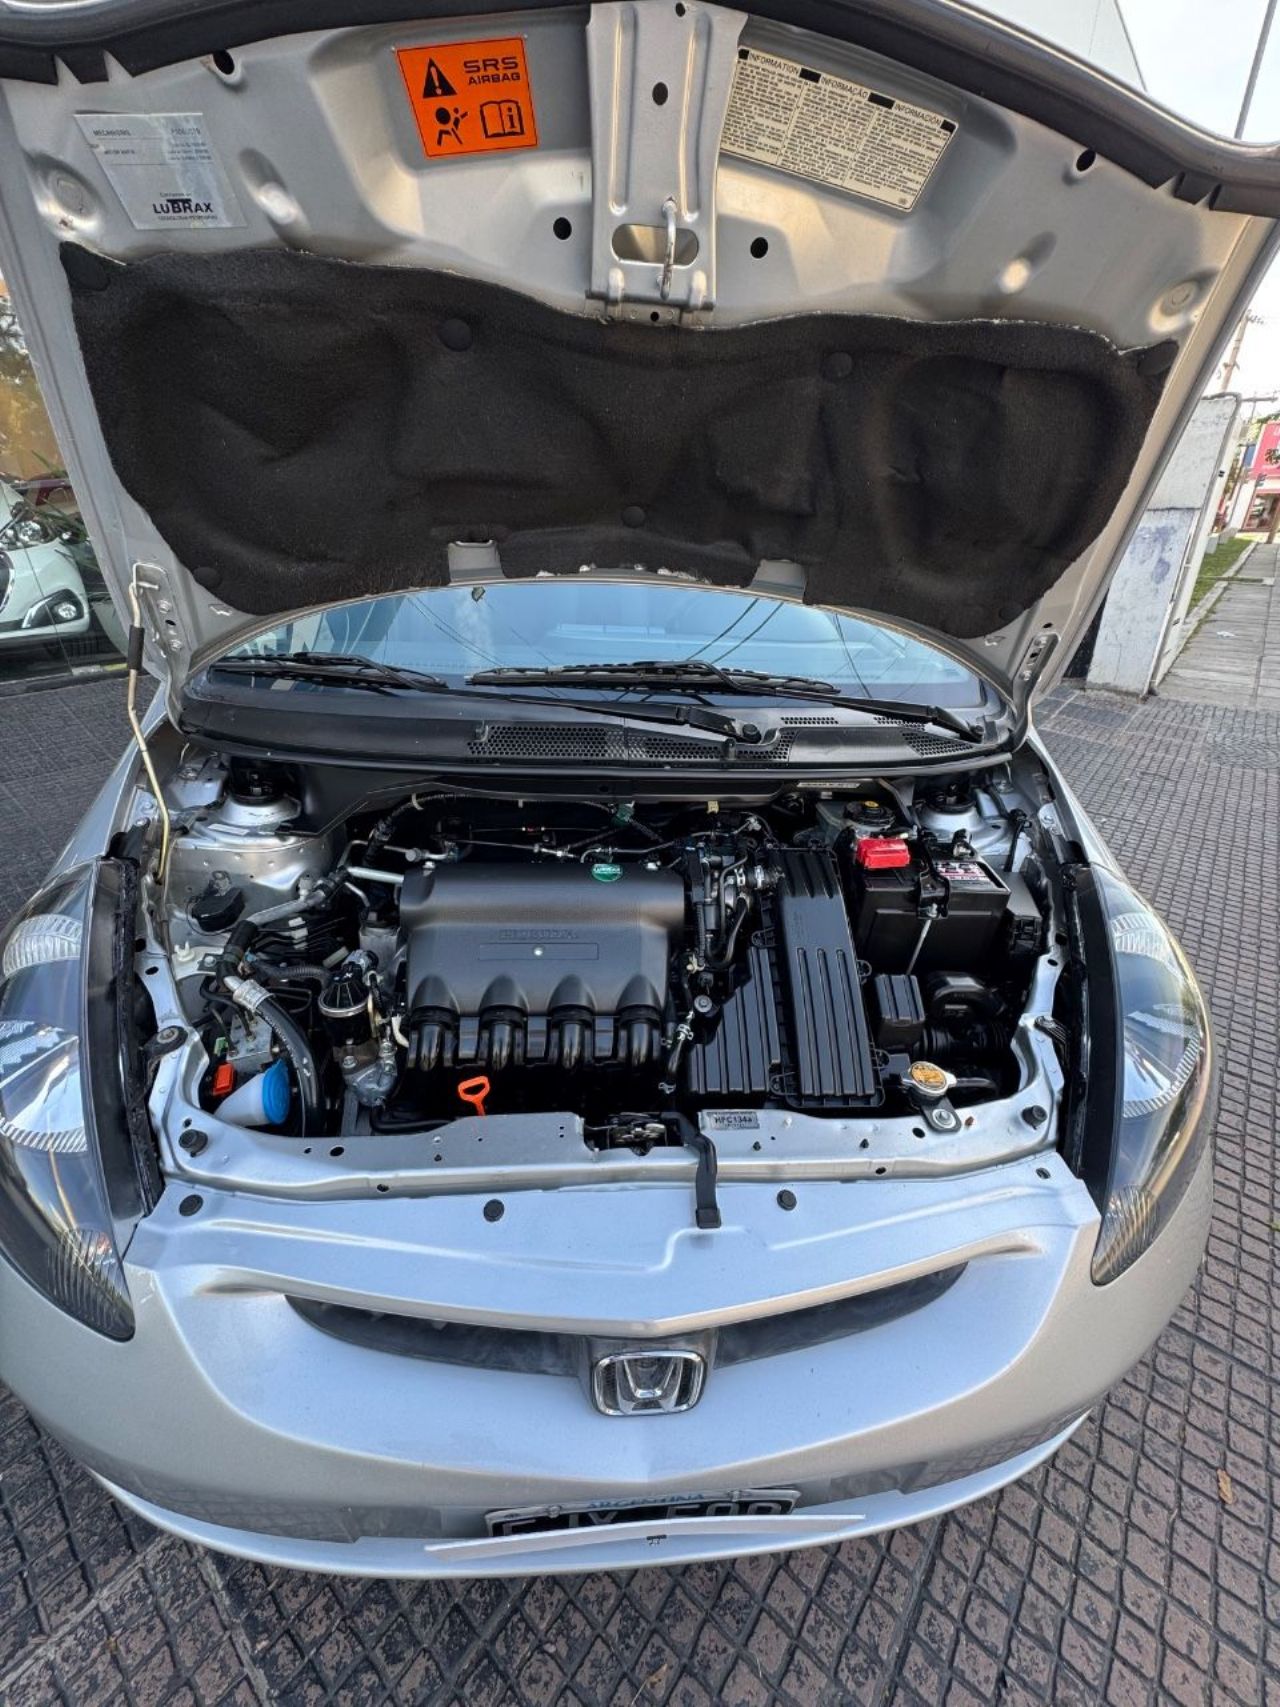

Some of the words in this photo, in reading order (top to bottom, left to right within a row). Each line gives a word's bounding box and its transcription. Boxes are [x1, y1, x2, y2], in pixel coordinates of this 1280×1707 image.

[464, 57, 518, 73] SRS
[749, 52, 799, 74] INFORMATION
[468, 73, 521, 86] AIRBAG
[152, 200, 214, 214] LUBRAX
[714, 1115, 753, 1124] HFC134a
